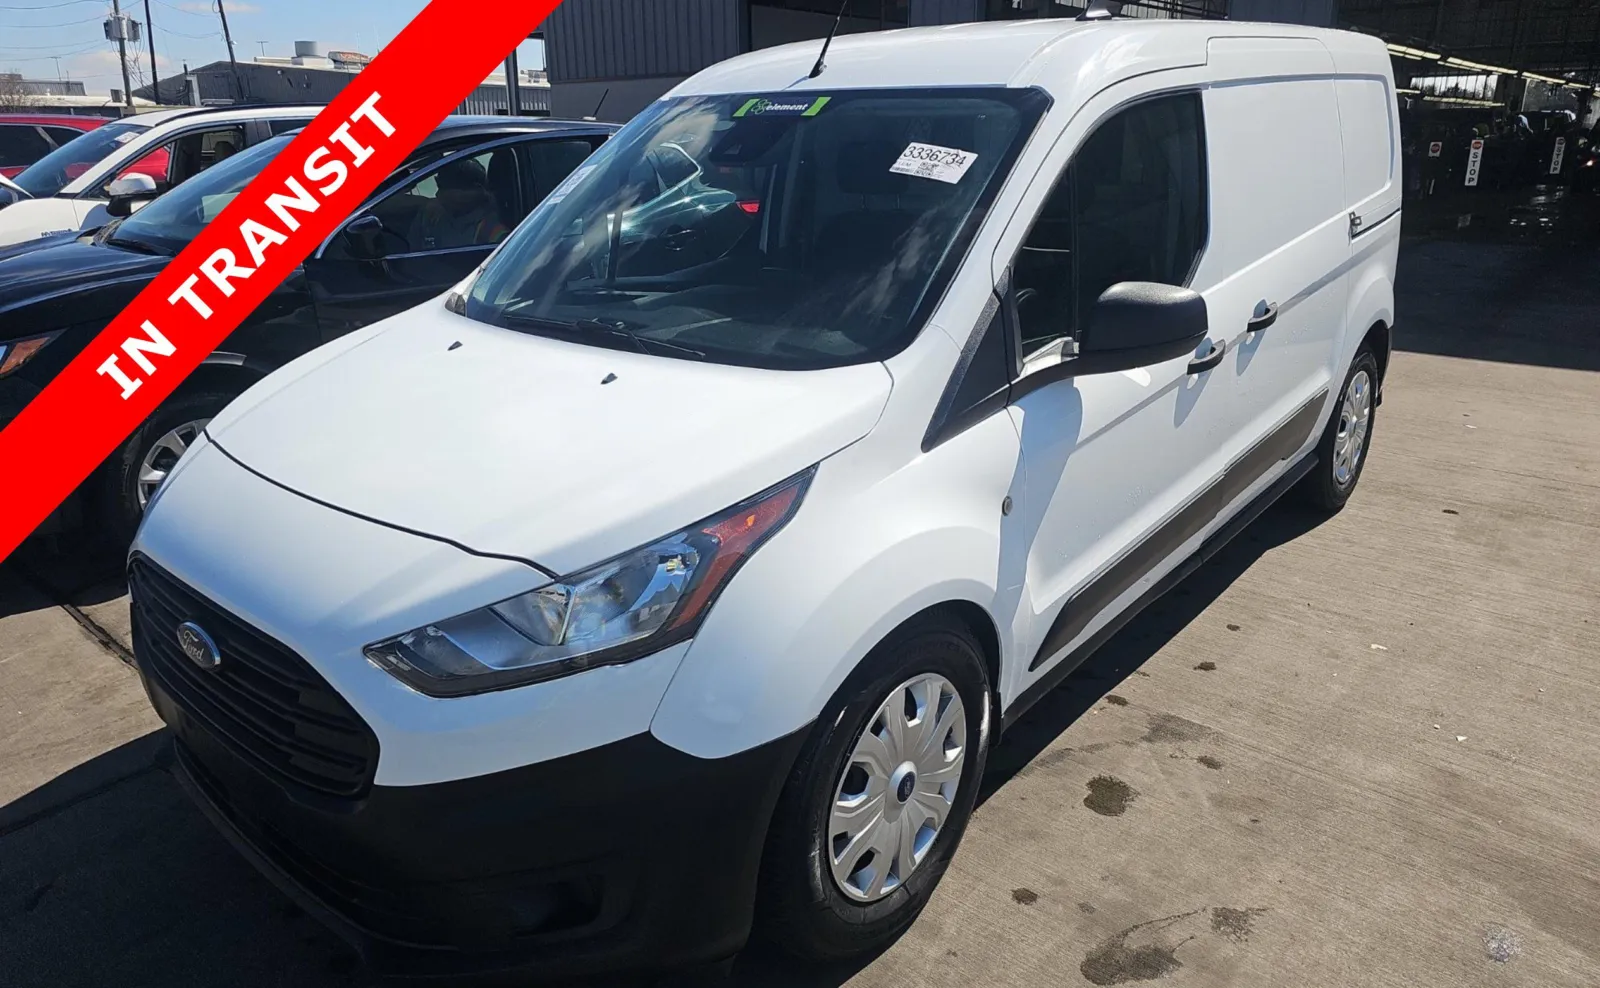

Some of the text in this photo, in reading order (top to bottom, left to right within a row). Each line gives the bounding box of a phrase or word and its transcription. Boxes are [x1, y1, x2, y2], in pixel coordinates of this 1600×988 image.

[766, 103, 809, 111] element
[903, 146, 967, 166] 3336734
[1467, 151, 1479, 185] STOP
[1552, 146, 1562, 173] STOP
[183, 630, 205, 661] Ford
